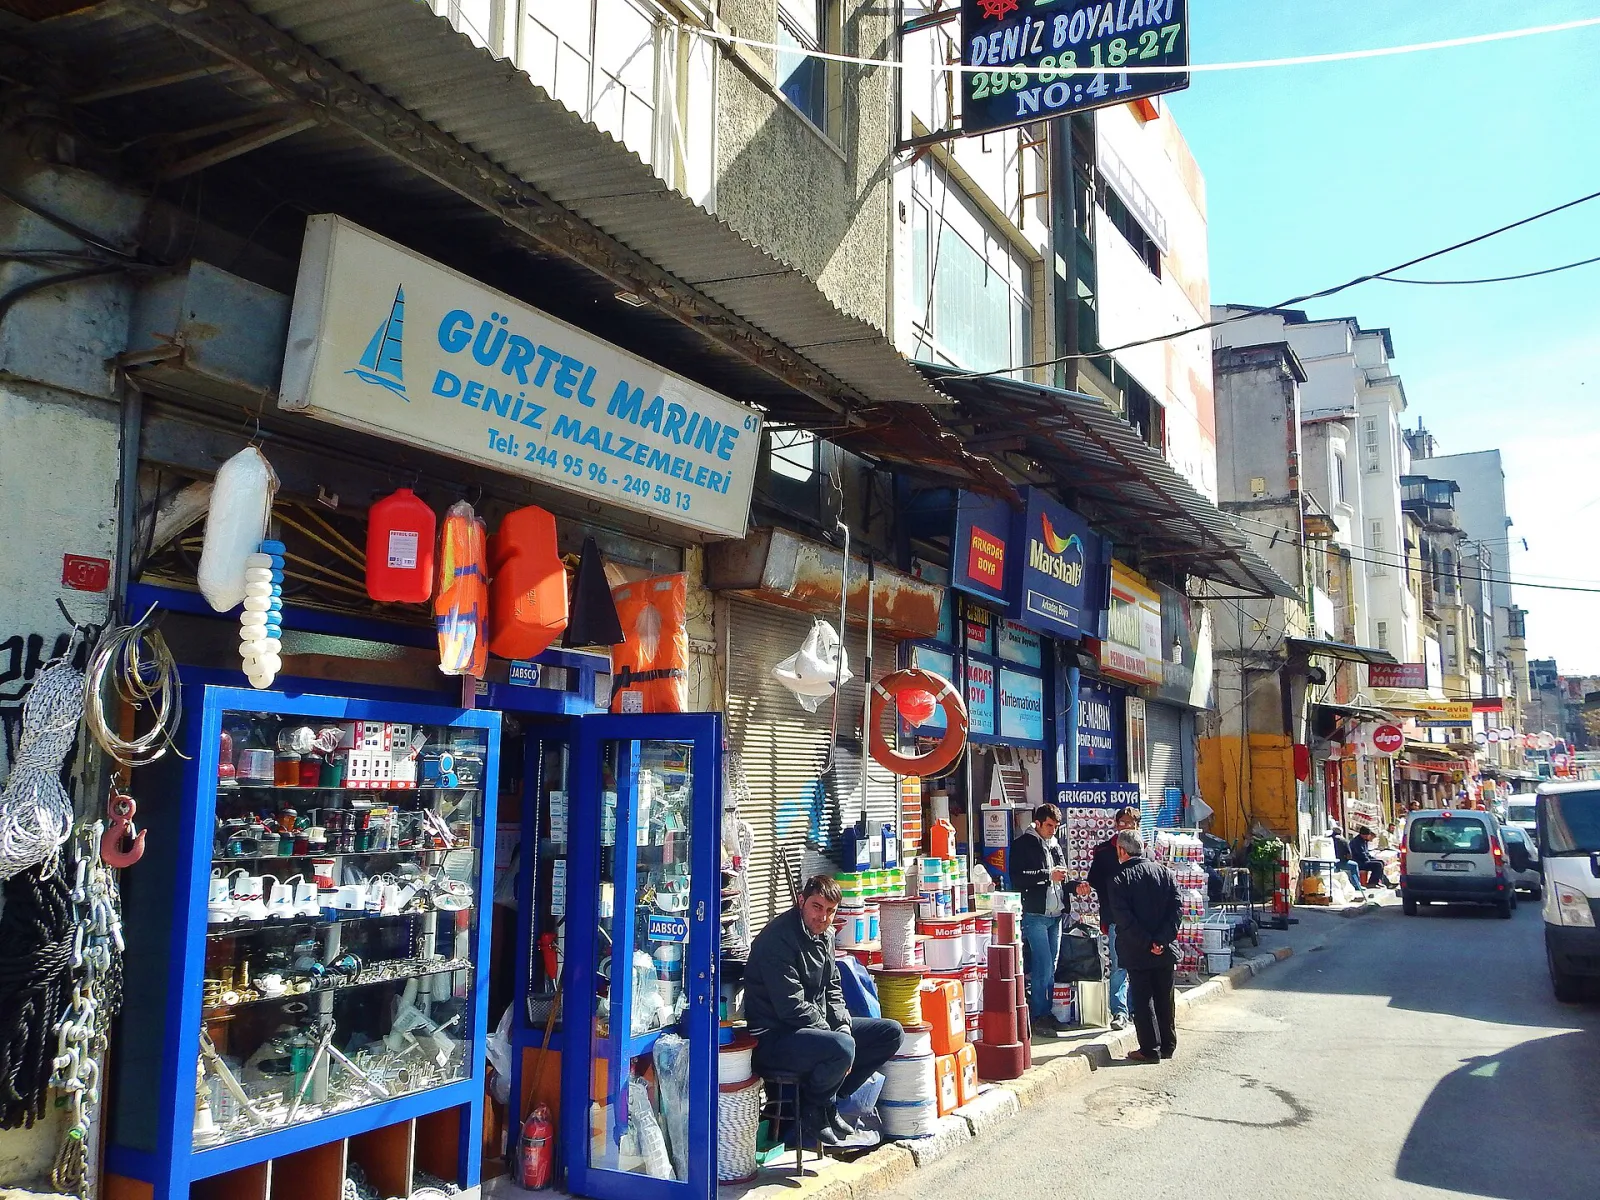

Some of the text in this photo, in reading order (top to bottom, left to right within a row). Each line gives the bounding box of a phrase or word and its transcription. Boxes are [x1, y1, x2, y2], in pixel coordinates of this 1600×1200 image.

[970, 16, 1045, 66] DENİZ
[971, 24, 1181, 100] 293 88 18-27
[437, 309, 740, 461] GÜRTEL MARINE
[432, 369, 733, 496] DENİZ MALZEMELERİ
[743, 415, 758, 434] 61
[487, 428, 518, 457] Tel:
[524, 441, 559, 469] 244
[562, 453, 584, 477] 95
[587, 461, 608, 485] 96
[623, 474, 650, 498] 249
[653, 484, 672, 506] 58
[675, 491, 692, 512] 13
[977, 556, 996, 576] BOYA
[1029, 538, 1082, 587] Marshall
[511, 667, 537, 680] JABSCO
[1004, 690, 1040, 713] International
[1375, 733, 1401, 745] dyo
[1058, 789, 1139, 804] ARKADAŞ BOYA
[651, 922, 684, 935] JABSCO
